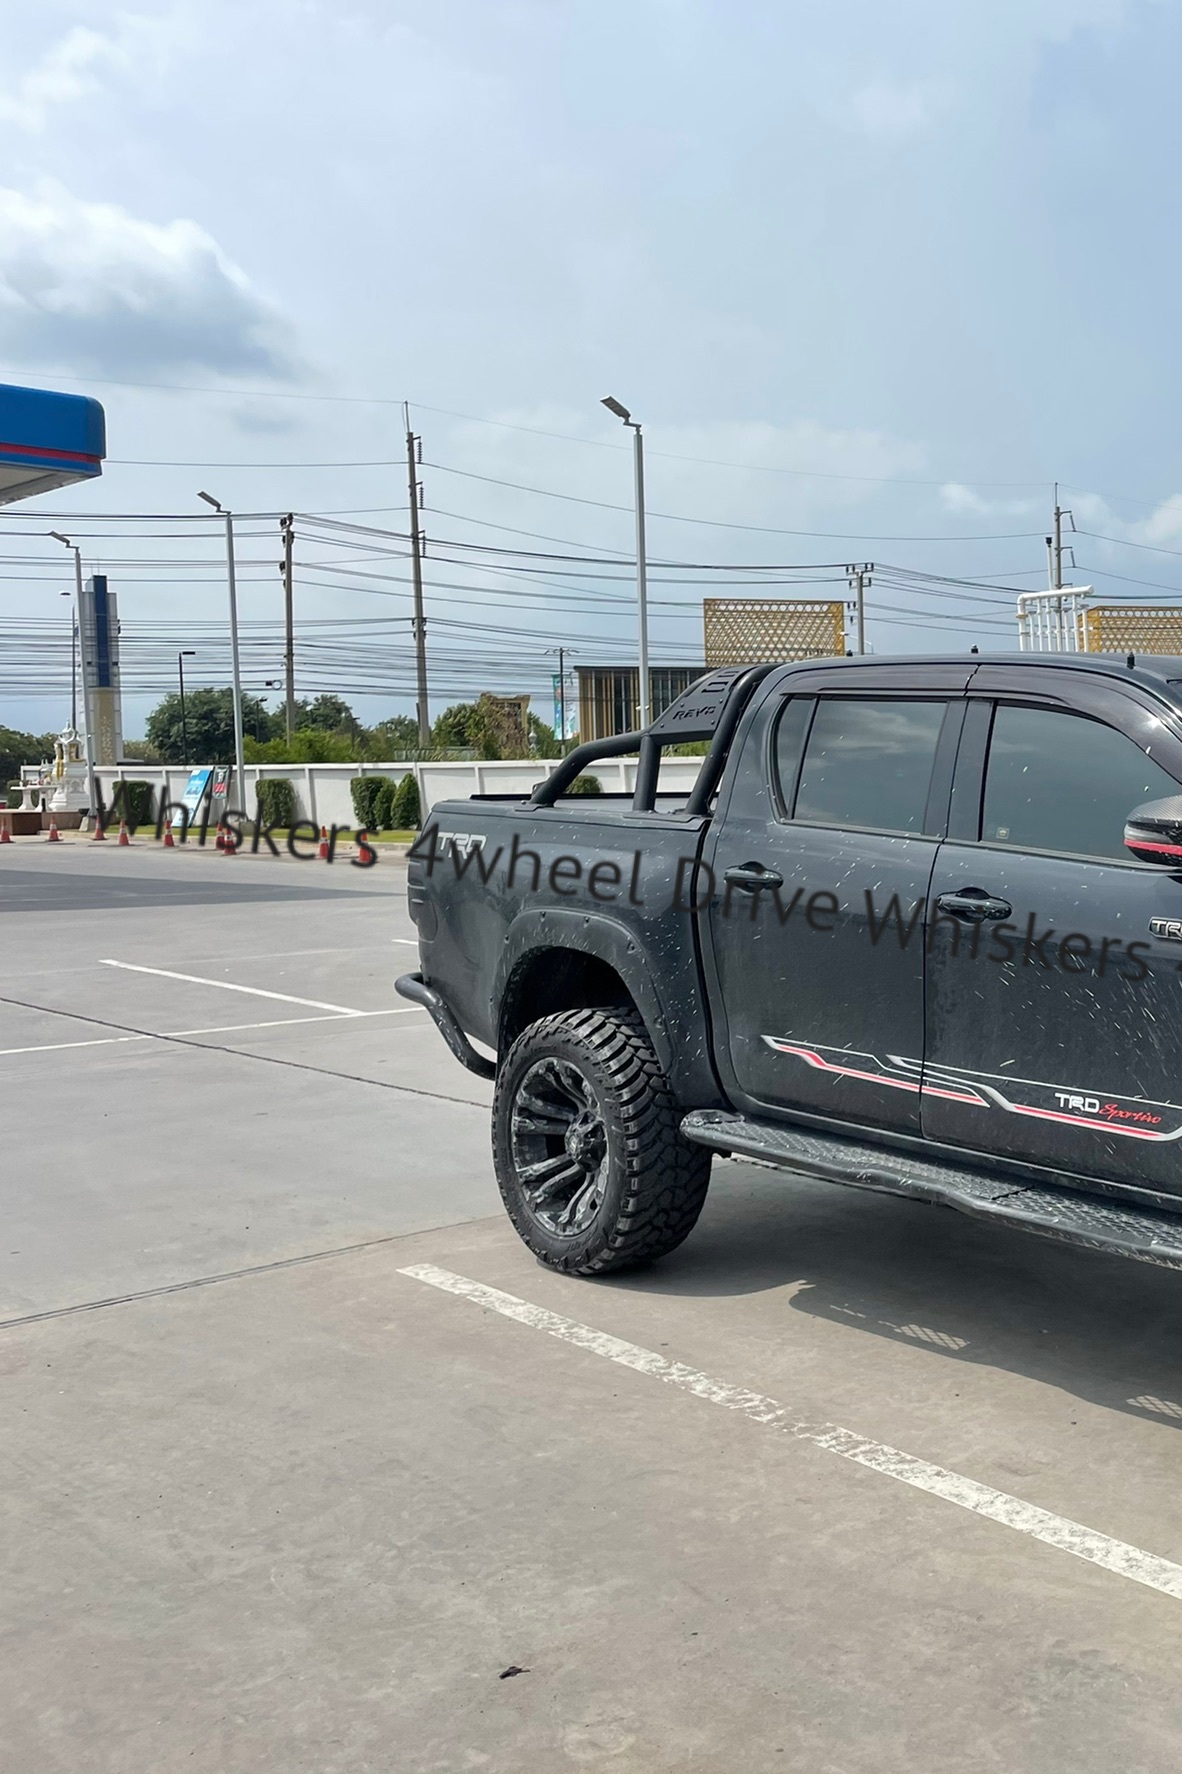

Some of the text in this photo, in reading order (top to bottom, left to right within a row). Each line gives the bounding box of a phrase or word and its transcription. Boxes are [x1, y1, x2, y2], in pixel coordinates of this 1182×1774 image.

[438, 832, 486, 859] TRD
[1055, 1093, 1162, 1125] TRD Sportivo
